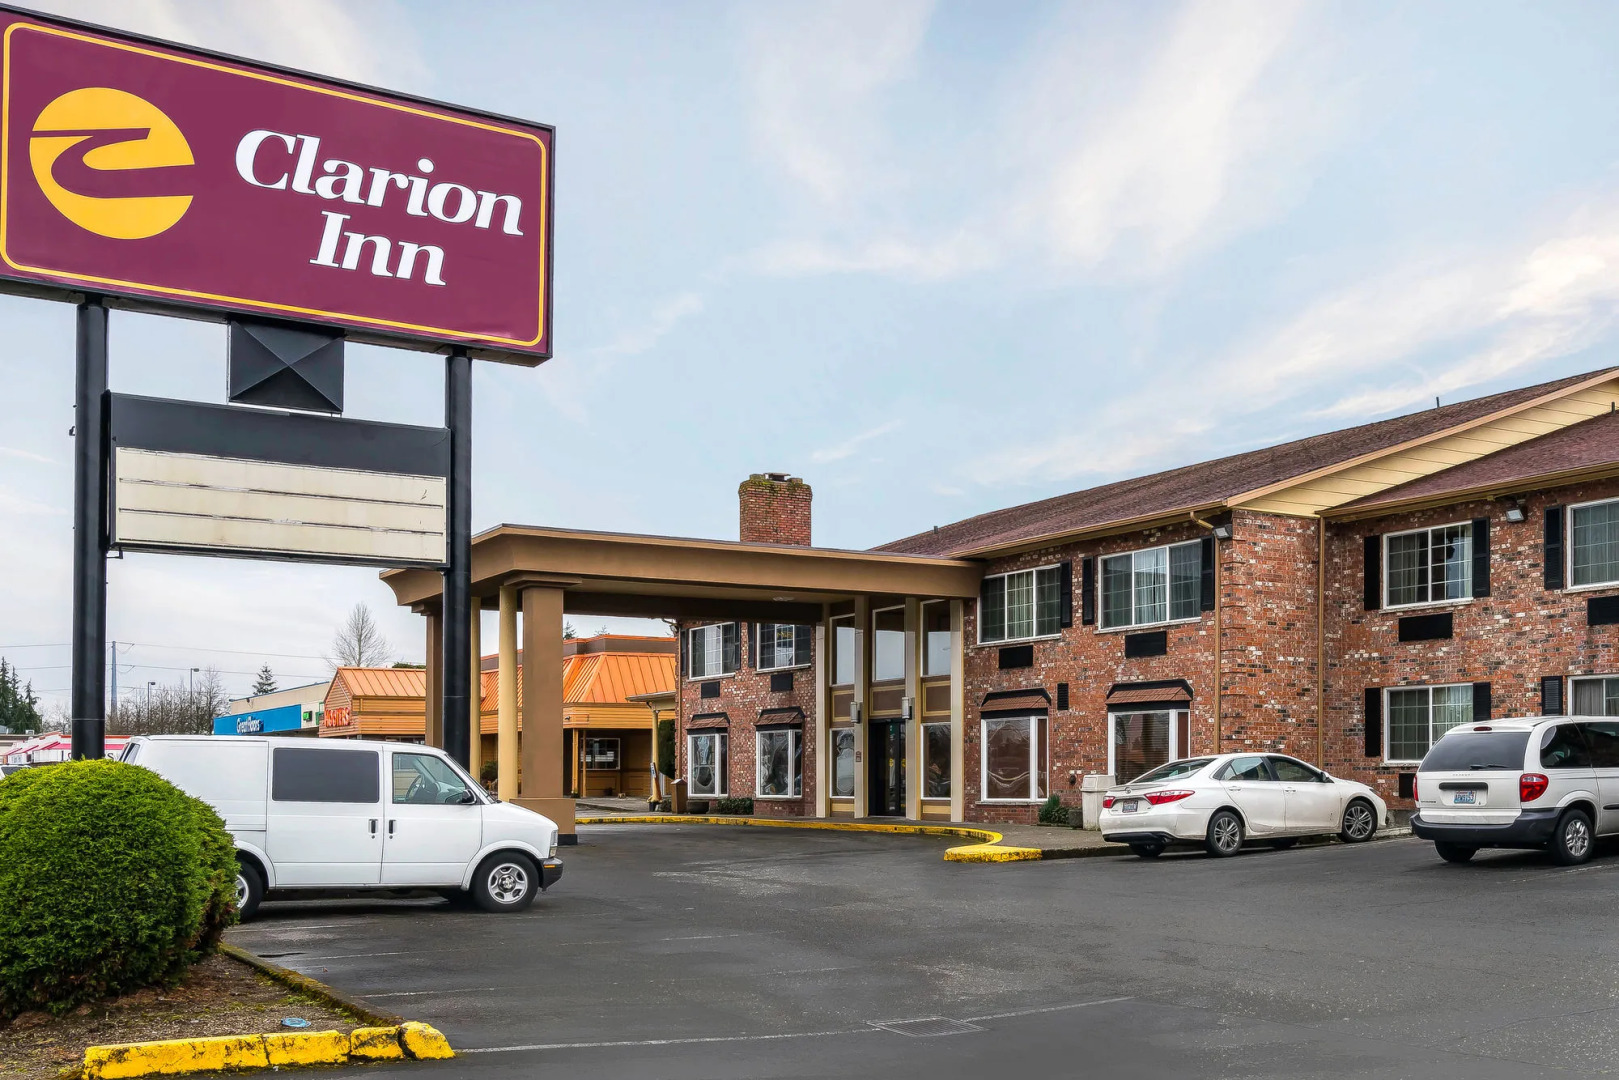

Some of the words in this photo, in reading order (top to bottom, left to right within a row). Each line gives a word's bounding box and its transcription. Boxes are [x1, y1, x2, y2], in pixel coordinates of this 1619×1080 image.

[235, 129, 524, 236] Clarion
[309, 210, 446, 286] Inn
[325, 707, 350, 727] HOOTERS
